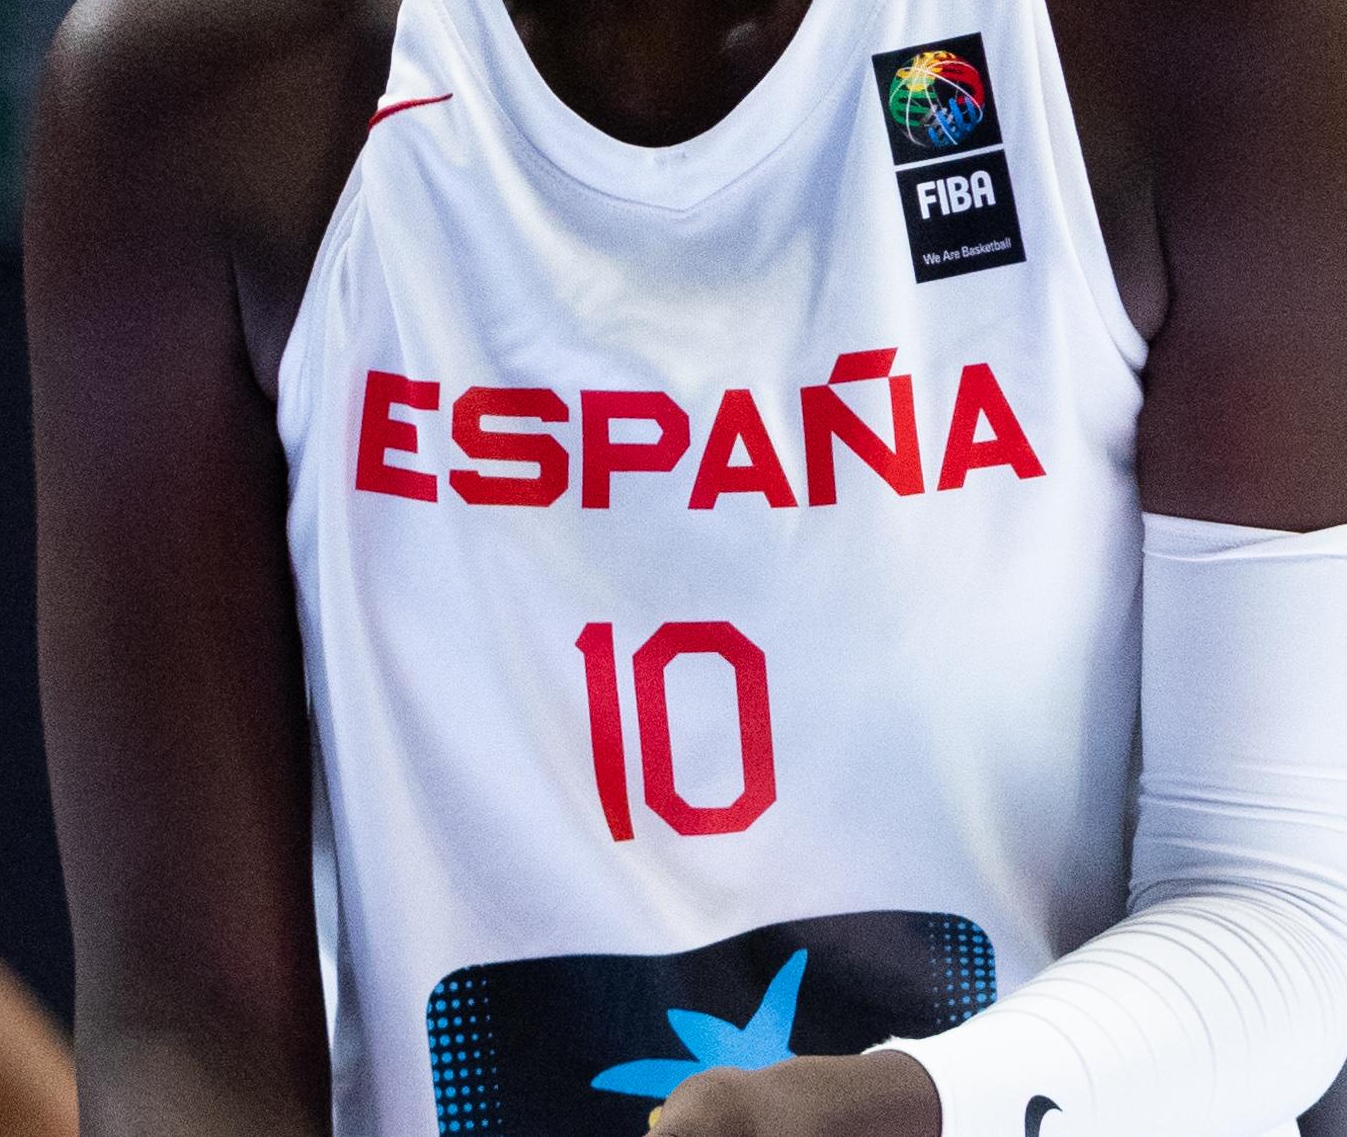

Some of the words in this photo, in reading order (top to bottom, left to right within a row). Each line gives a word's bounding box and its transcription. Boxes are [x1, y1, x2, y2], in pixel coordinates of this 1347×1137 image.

[916, 170, 996, 219] FIBA
[923, 253, 941, 265] We
[943, 249, 961, 262] Are
[961, 238, 1012, 258] Basketball
[354, 347, 1047, 510] ESPAÑA
[575, 620, 778, 843] 10
